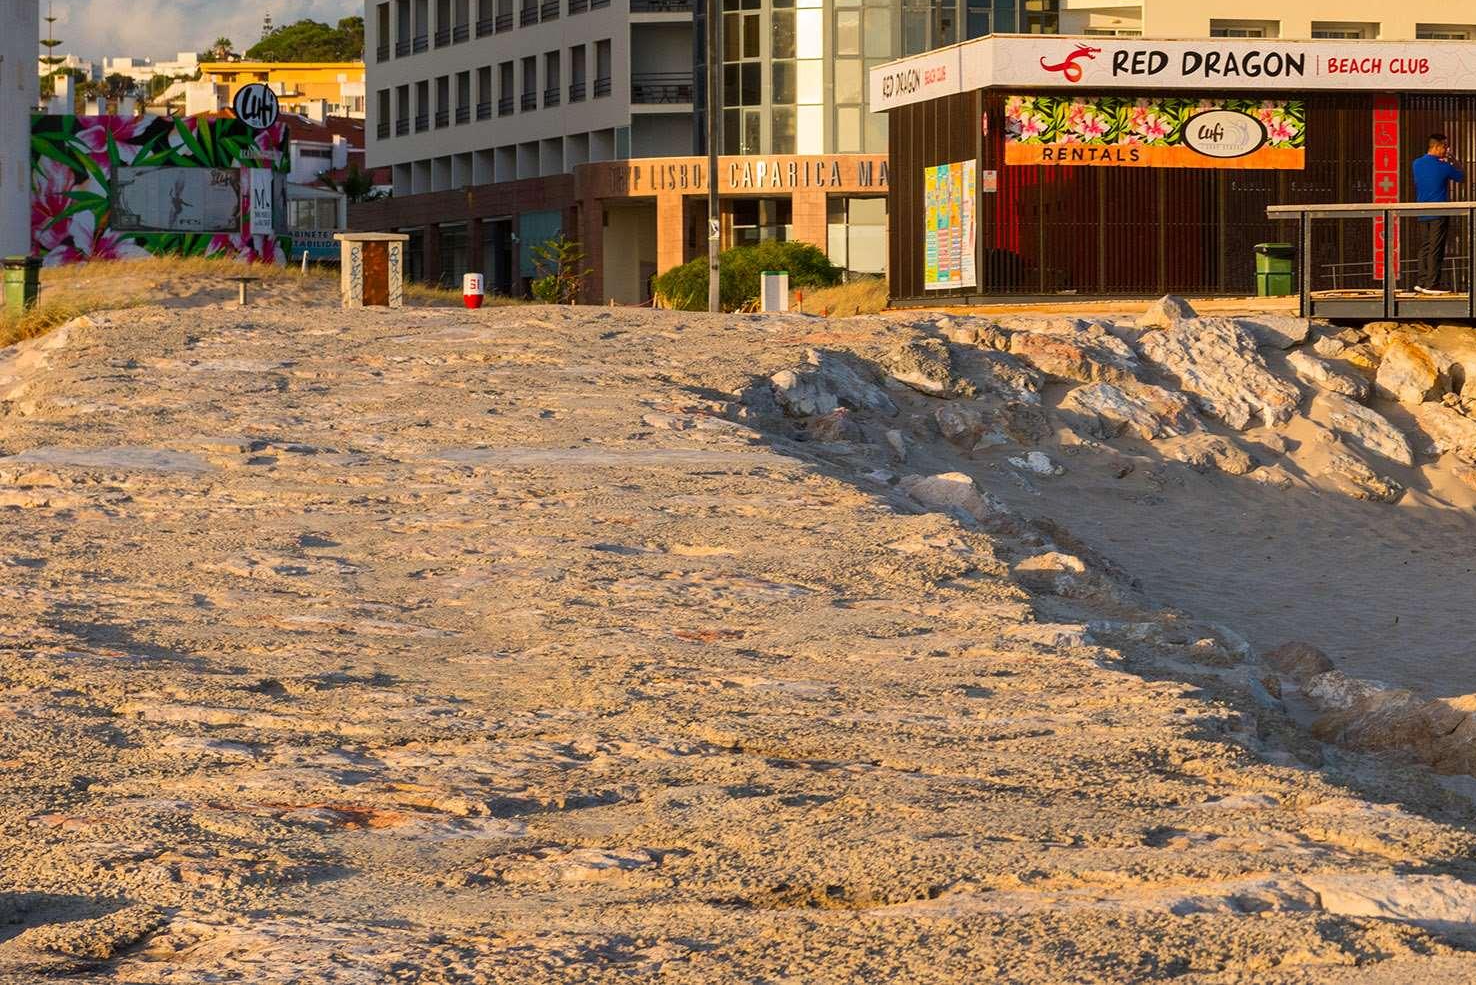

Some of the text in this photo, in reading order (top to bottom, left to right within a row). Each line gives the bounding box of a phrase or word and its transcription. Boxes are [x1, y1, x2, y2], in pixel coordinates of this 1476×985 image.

[1112, 50, 1430, 78] RED DRAGON BEACH CLUB
[1042, 147, 1140, 162] RENTALS
[650, 163, 710, 191] LISBO
[728, 160, 842, 188] CAPARICA
